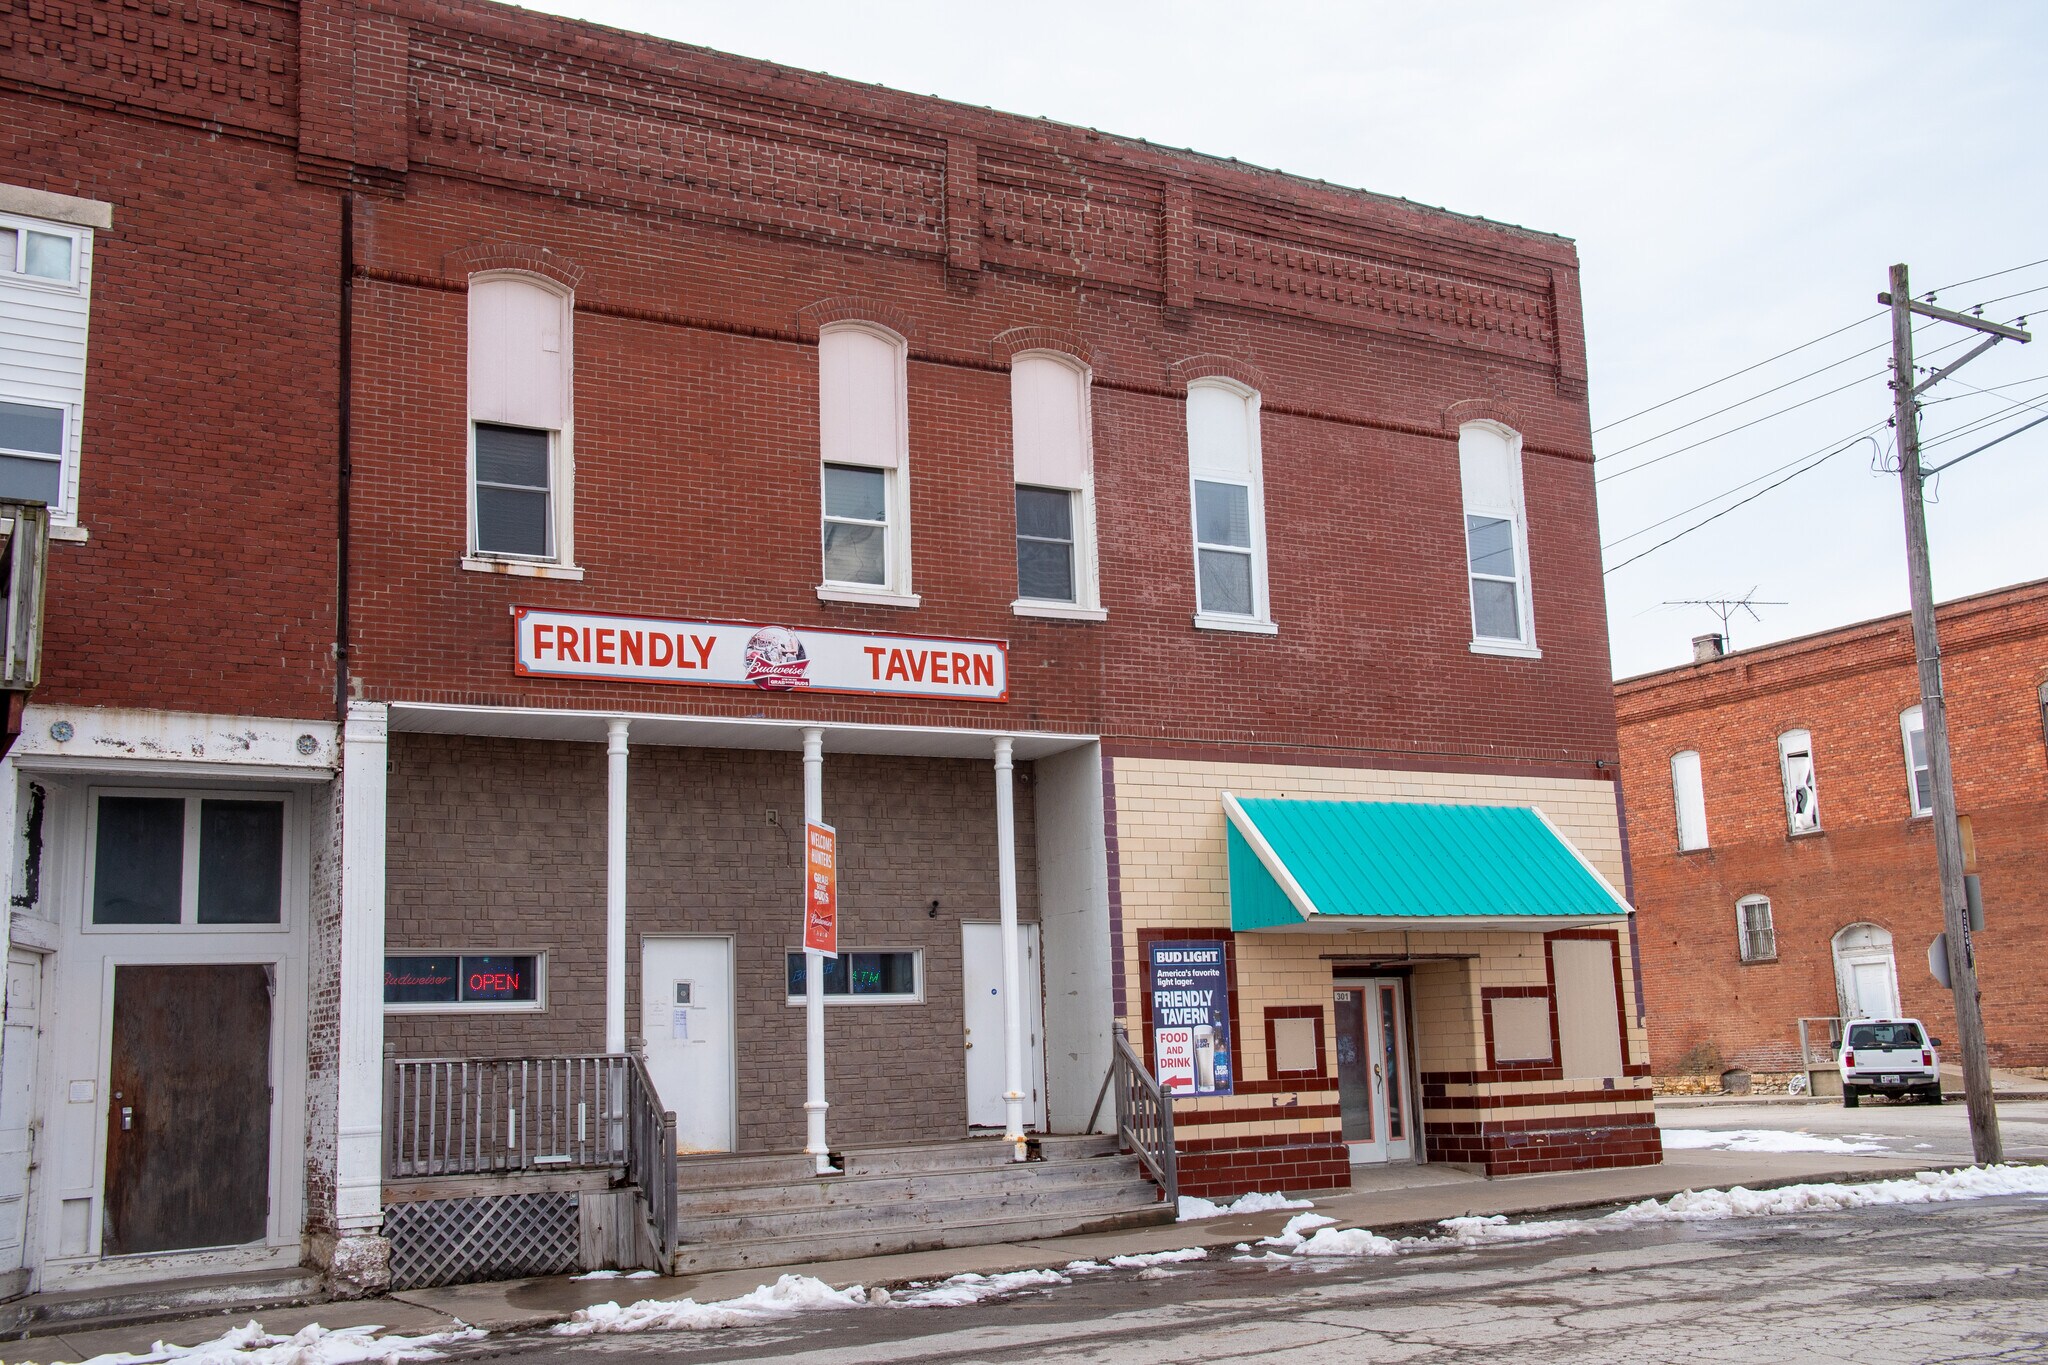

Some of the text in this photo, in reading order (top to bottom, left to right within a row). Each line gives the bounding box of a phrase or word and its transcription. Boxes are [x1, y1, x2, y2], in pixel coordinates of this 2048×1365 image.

[534, 623, 994, 687] FRIENDLY TAVERN
[810, 830, 833, 853] WELCOME
[811, 847, 832, 869] HUNTERS
[1156, 951, 1218, 964] BUD LIGHT
[384, 971, 452, 986] Budweiser
[852, 970, 880, 983] ATM
[1157, 968, 1220, 978] America's favorite
[469, 973, 519, 991] OPEN
[1157, 978, 1195, 987] light lager.
[1154, 990, 1213, 1007] FRIENDLY
[1336, 992, 1349, 1001] 301
[1161, 1008, 1209, 1025] TAVERN
[1160, 1032, 1188, 1043] FOOD
[1166, 1046, 1184, 1055] AND
[1160, 1057, 1191, 1069] DRINK
